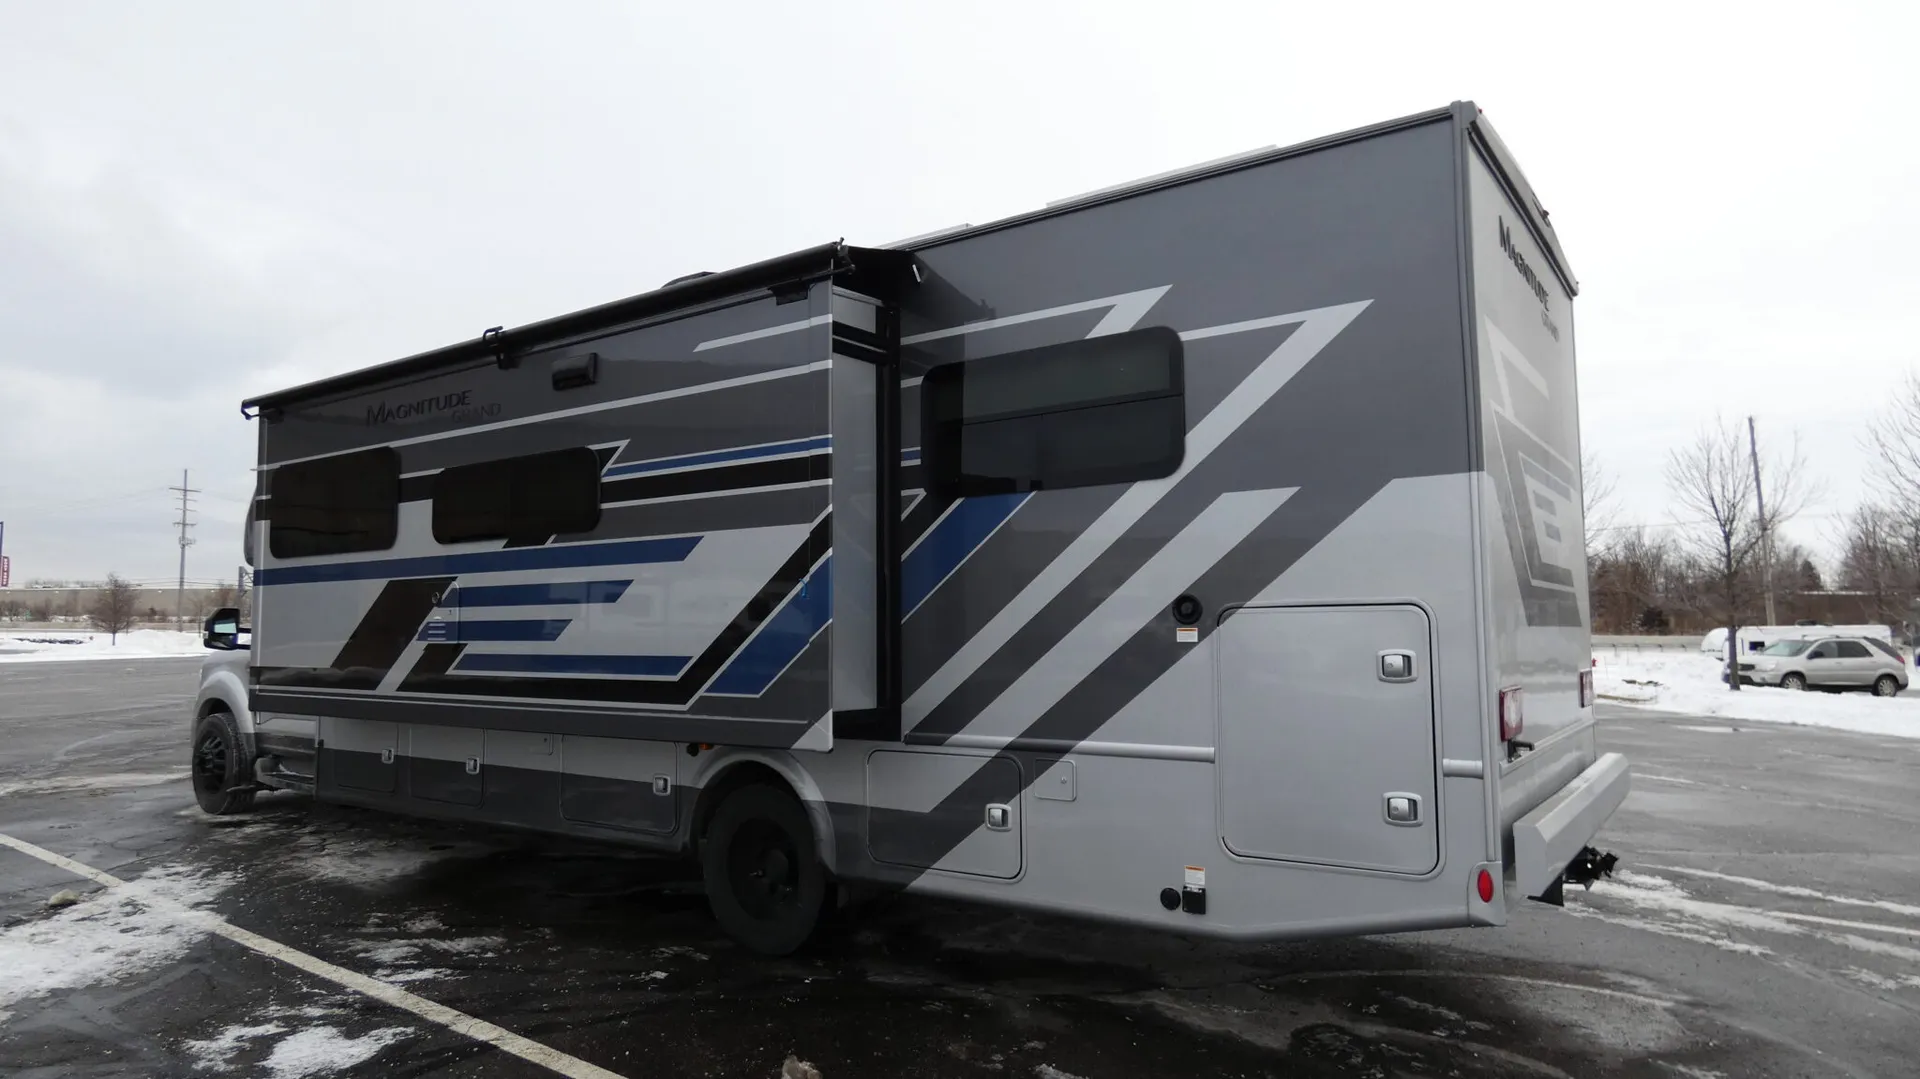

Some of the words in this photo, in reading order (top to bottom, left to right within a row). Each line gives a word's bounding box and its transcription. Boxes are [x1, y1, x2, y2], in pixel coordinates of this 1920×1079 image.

[1498, 215, 1550, 312] MAGNITUDE
[366, 389, 473, 425] MAGNITUDE
[451, 402, 502, 423] GRAND
